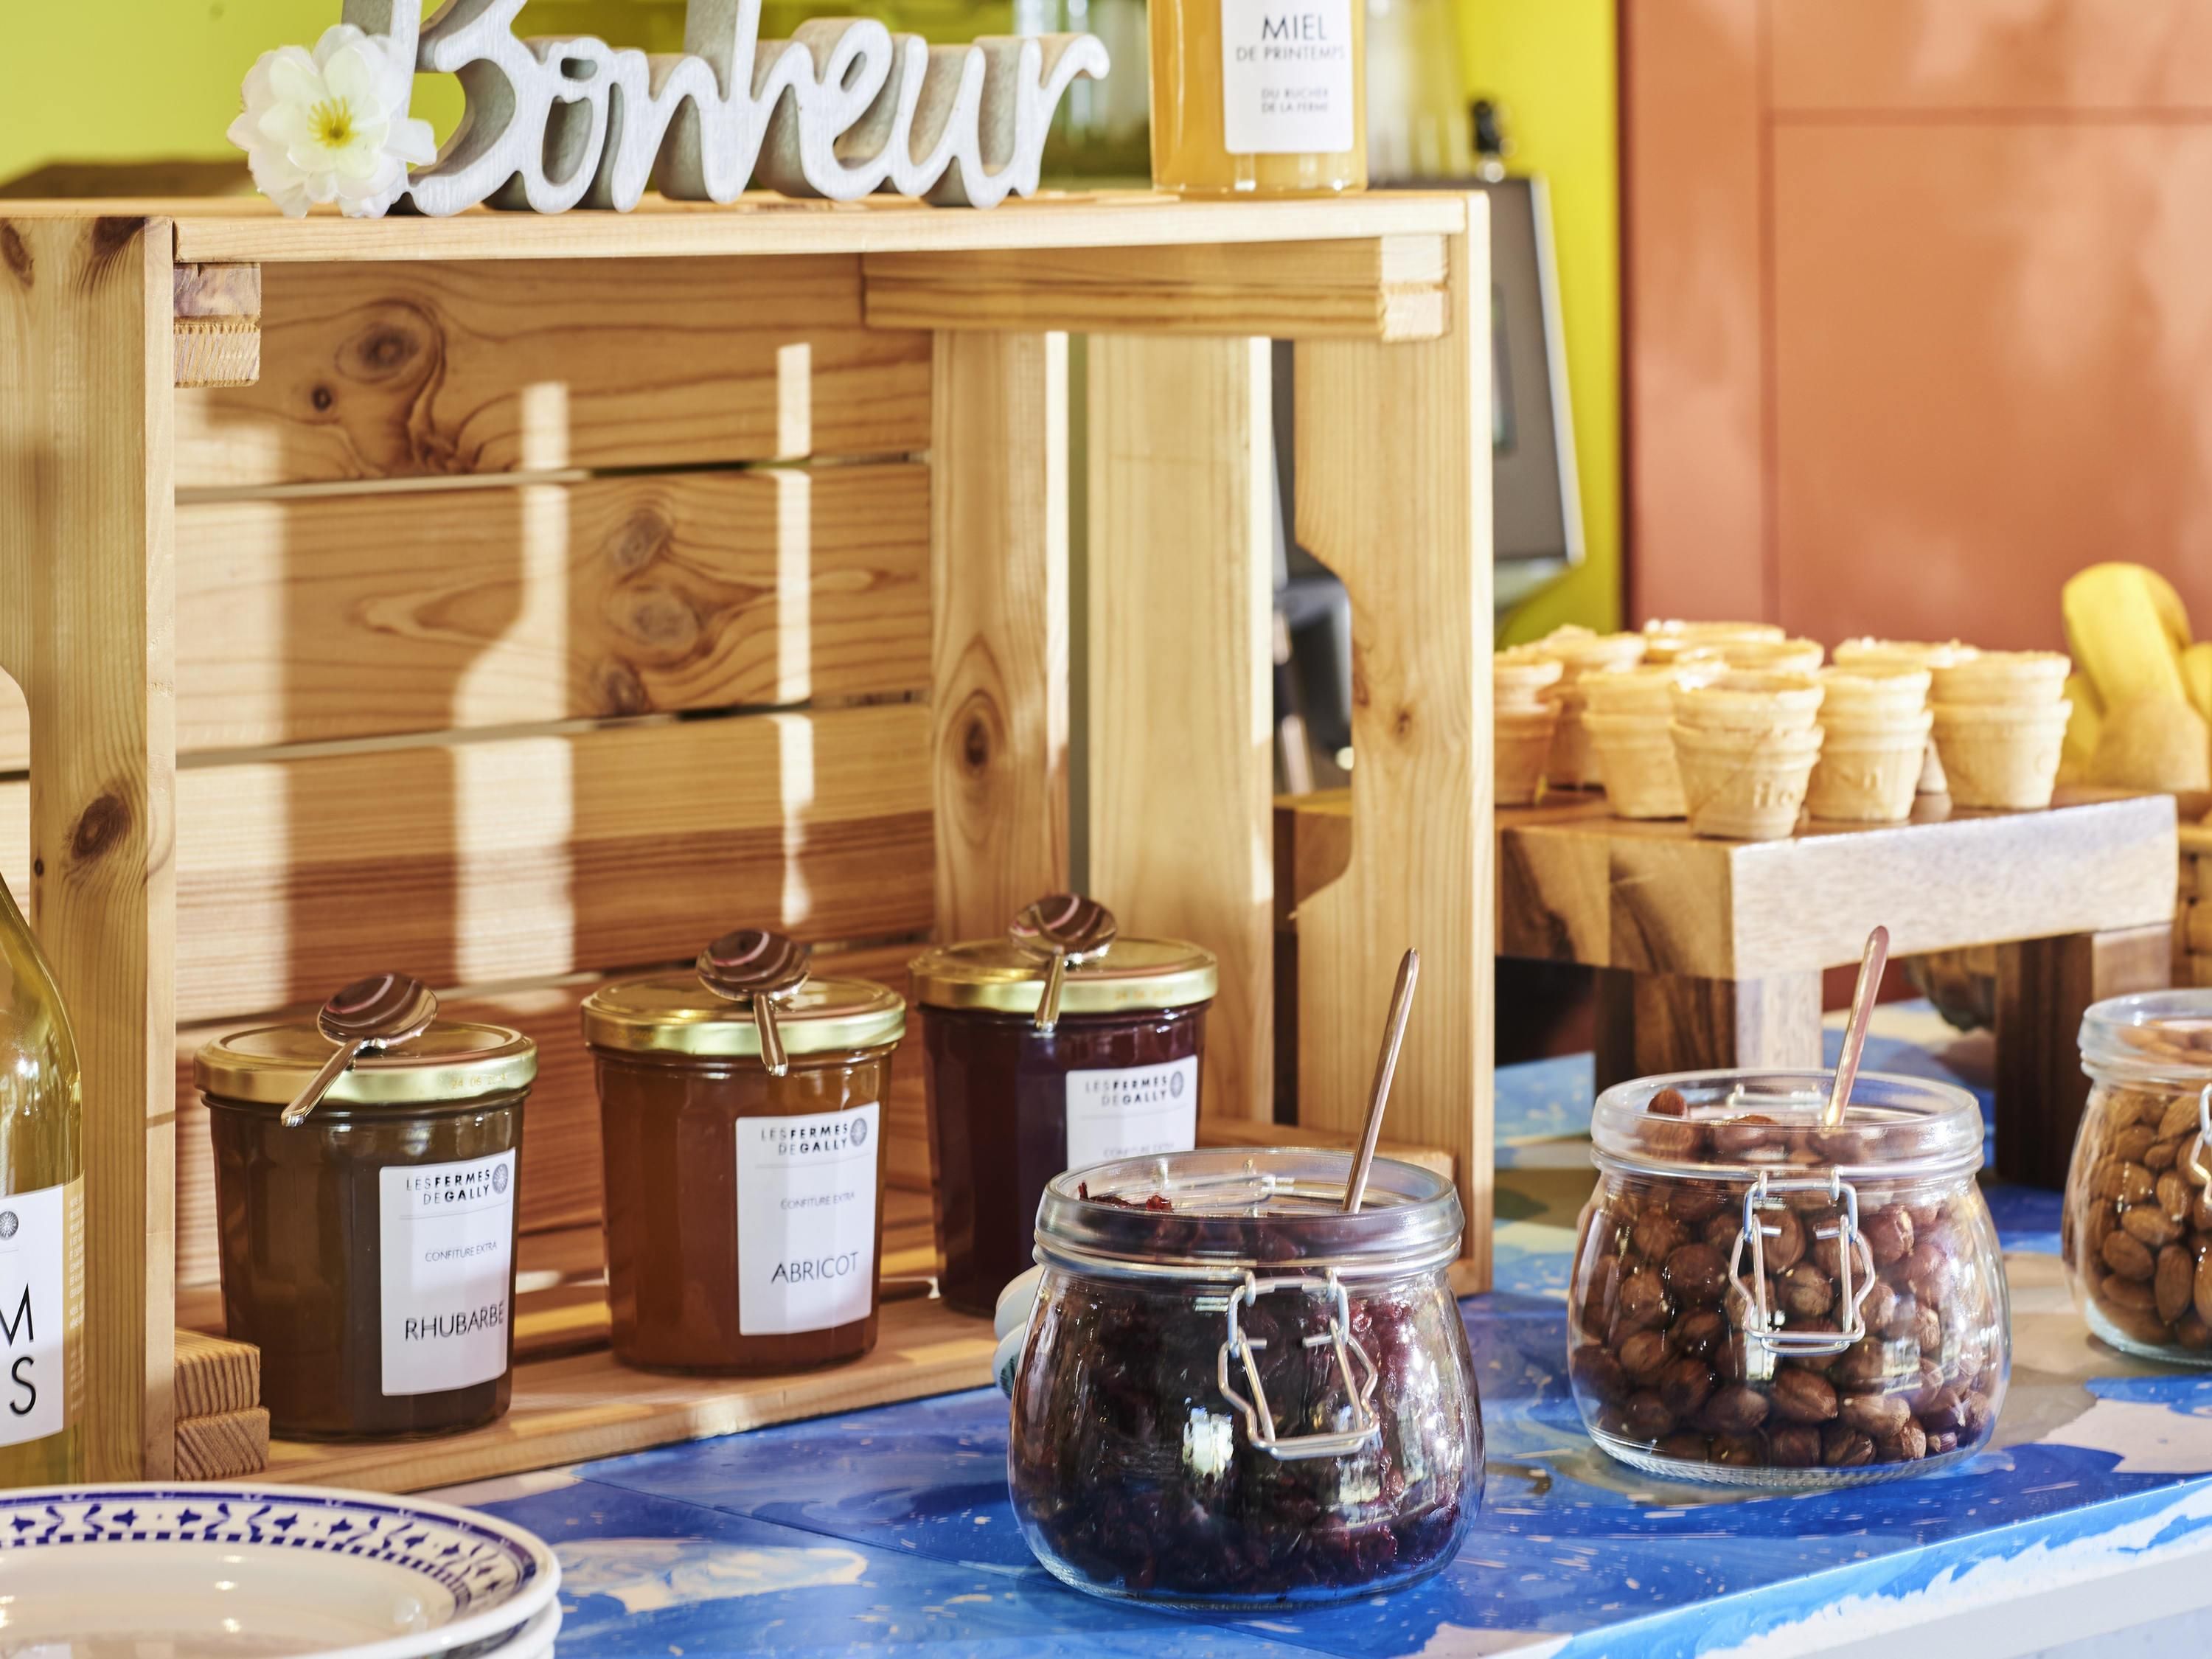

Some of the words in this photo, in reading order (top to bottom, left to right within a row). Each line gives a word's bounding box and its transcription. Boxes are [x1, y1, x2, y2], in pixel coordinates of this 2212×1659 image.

[1262, 15, 1328, 41] MIEL
[1236, 46, 1256, 62] DE
[1263, 44, 1345, 61] PRINTEMPS
[1261, 88, 1280, 100] DU
[389, 0, 1110, 218] Bonheur
[1261, 101, 1276, 114] DE
[1280, 101, 1293, 113] LA
[780, 1194, 831, 1210] CONFITURE
[832, 1191, 855, 1204] EXTRA
[425, 1245, 475, 1263] CONFITURE
[476, 1241, 498, 1256] EXTRA
[771, 1251, 860, 1285] ABRICOT
[405, 1300, 506, 1343] RHUBARBE
